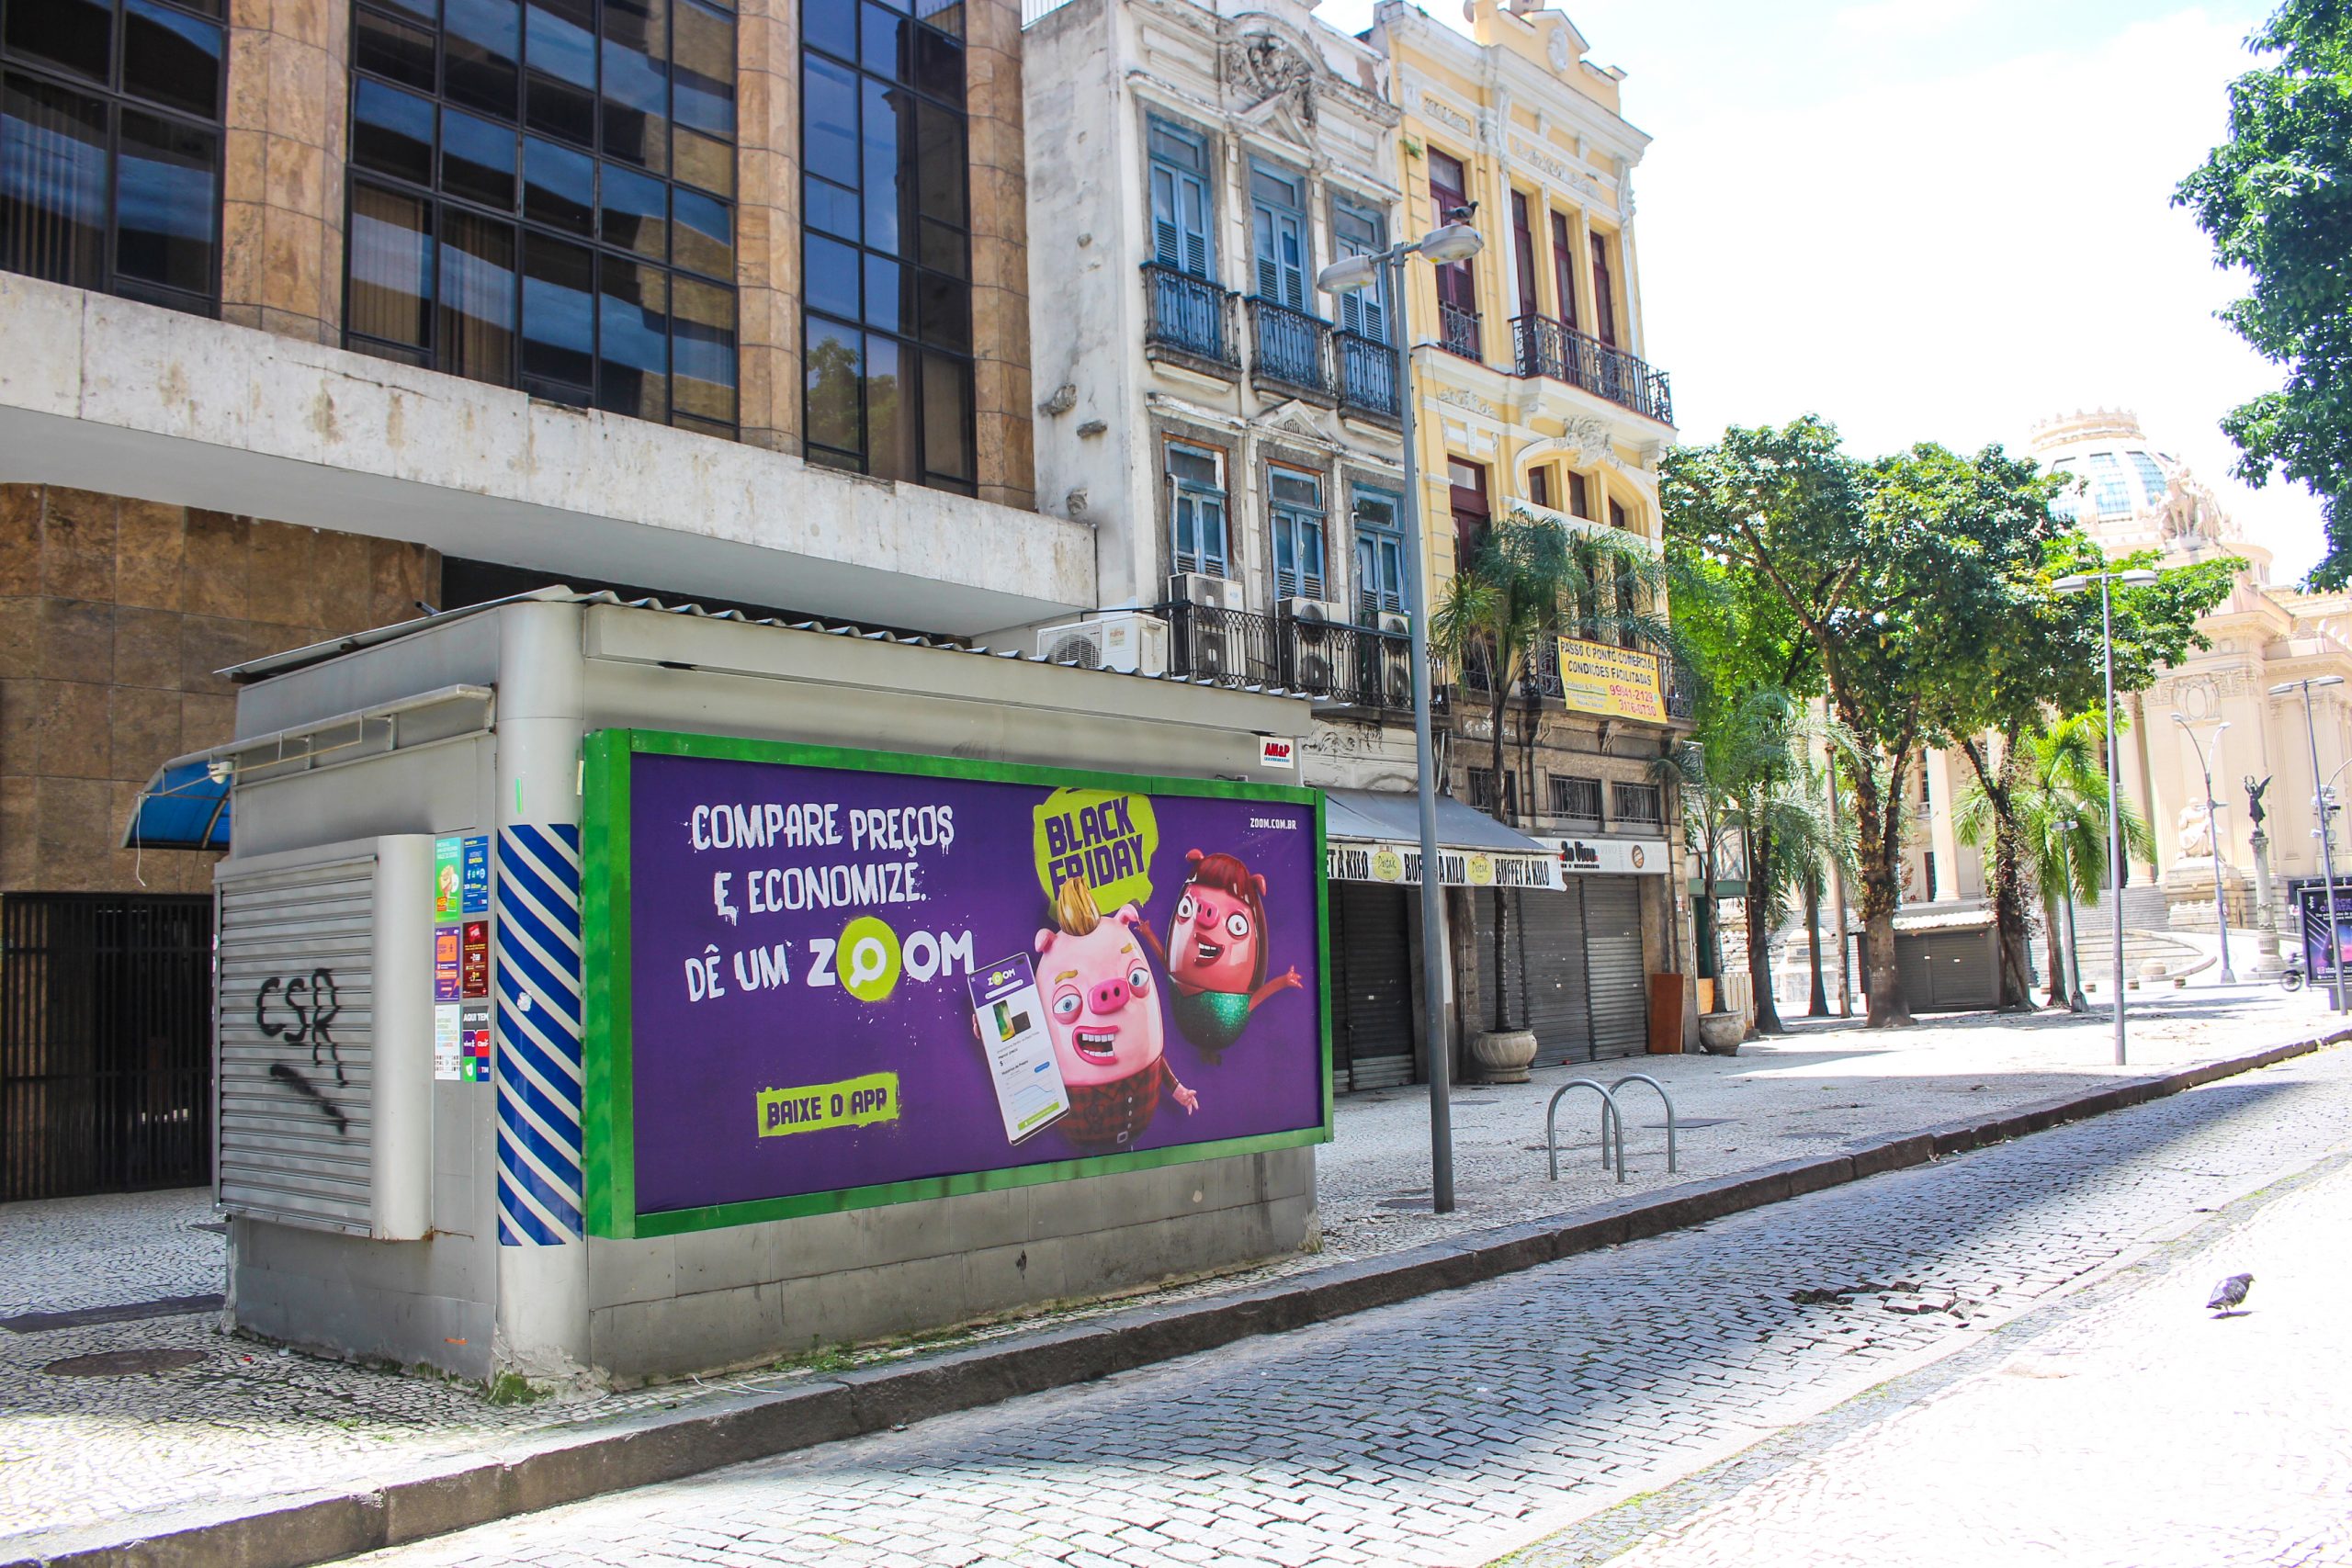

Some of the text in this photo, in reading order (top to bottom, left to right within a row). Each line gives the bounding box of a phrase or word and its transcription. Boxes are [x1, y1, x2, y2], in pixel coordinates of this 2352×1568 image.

[1561, 641, 1583, 657] PASSO
[1592, 648, 1616, 662] PONTO
[1611, 668, 1652, 686] FACILITADAS
[1264, 742, 1290, 757] AM&P
[692, 804, 955, 856] COMPARE PREÇOS
[1045, 795, 1136, 858] BLACK
[1250, 818, 1297, 829] ZOOM.COM.BR
[1048, 833, 1145, 900] FRIDAY
[1346, 851, 1369, 879] KILO
[1404, 853, 1422, 882] BUF
[1446, 856, 1465, 884] KILO
[1495, 859, 1524, 885] BUFFET
[1532, 860, 1550, 886] KILO
[714, 862, 927, 920] E ECONOMIZE.
[684, 919, 975, 1002] DÊ UM ZOOM
[987, 967, 1016, 987] ZOOM
[463, 1013, 477, 1022] AQUI
[766, 1087, 888, 1126] BAIXE O APP
